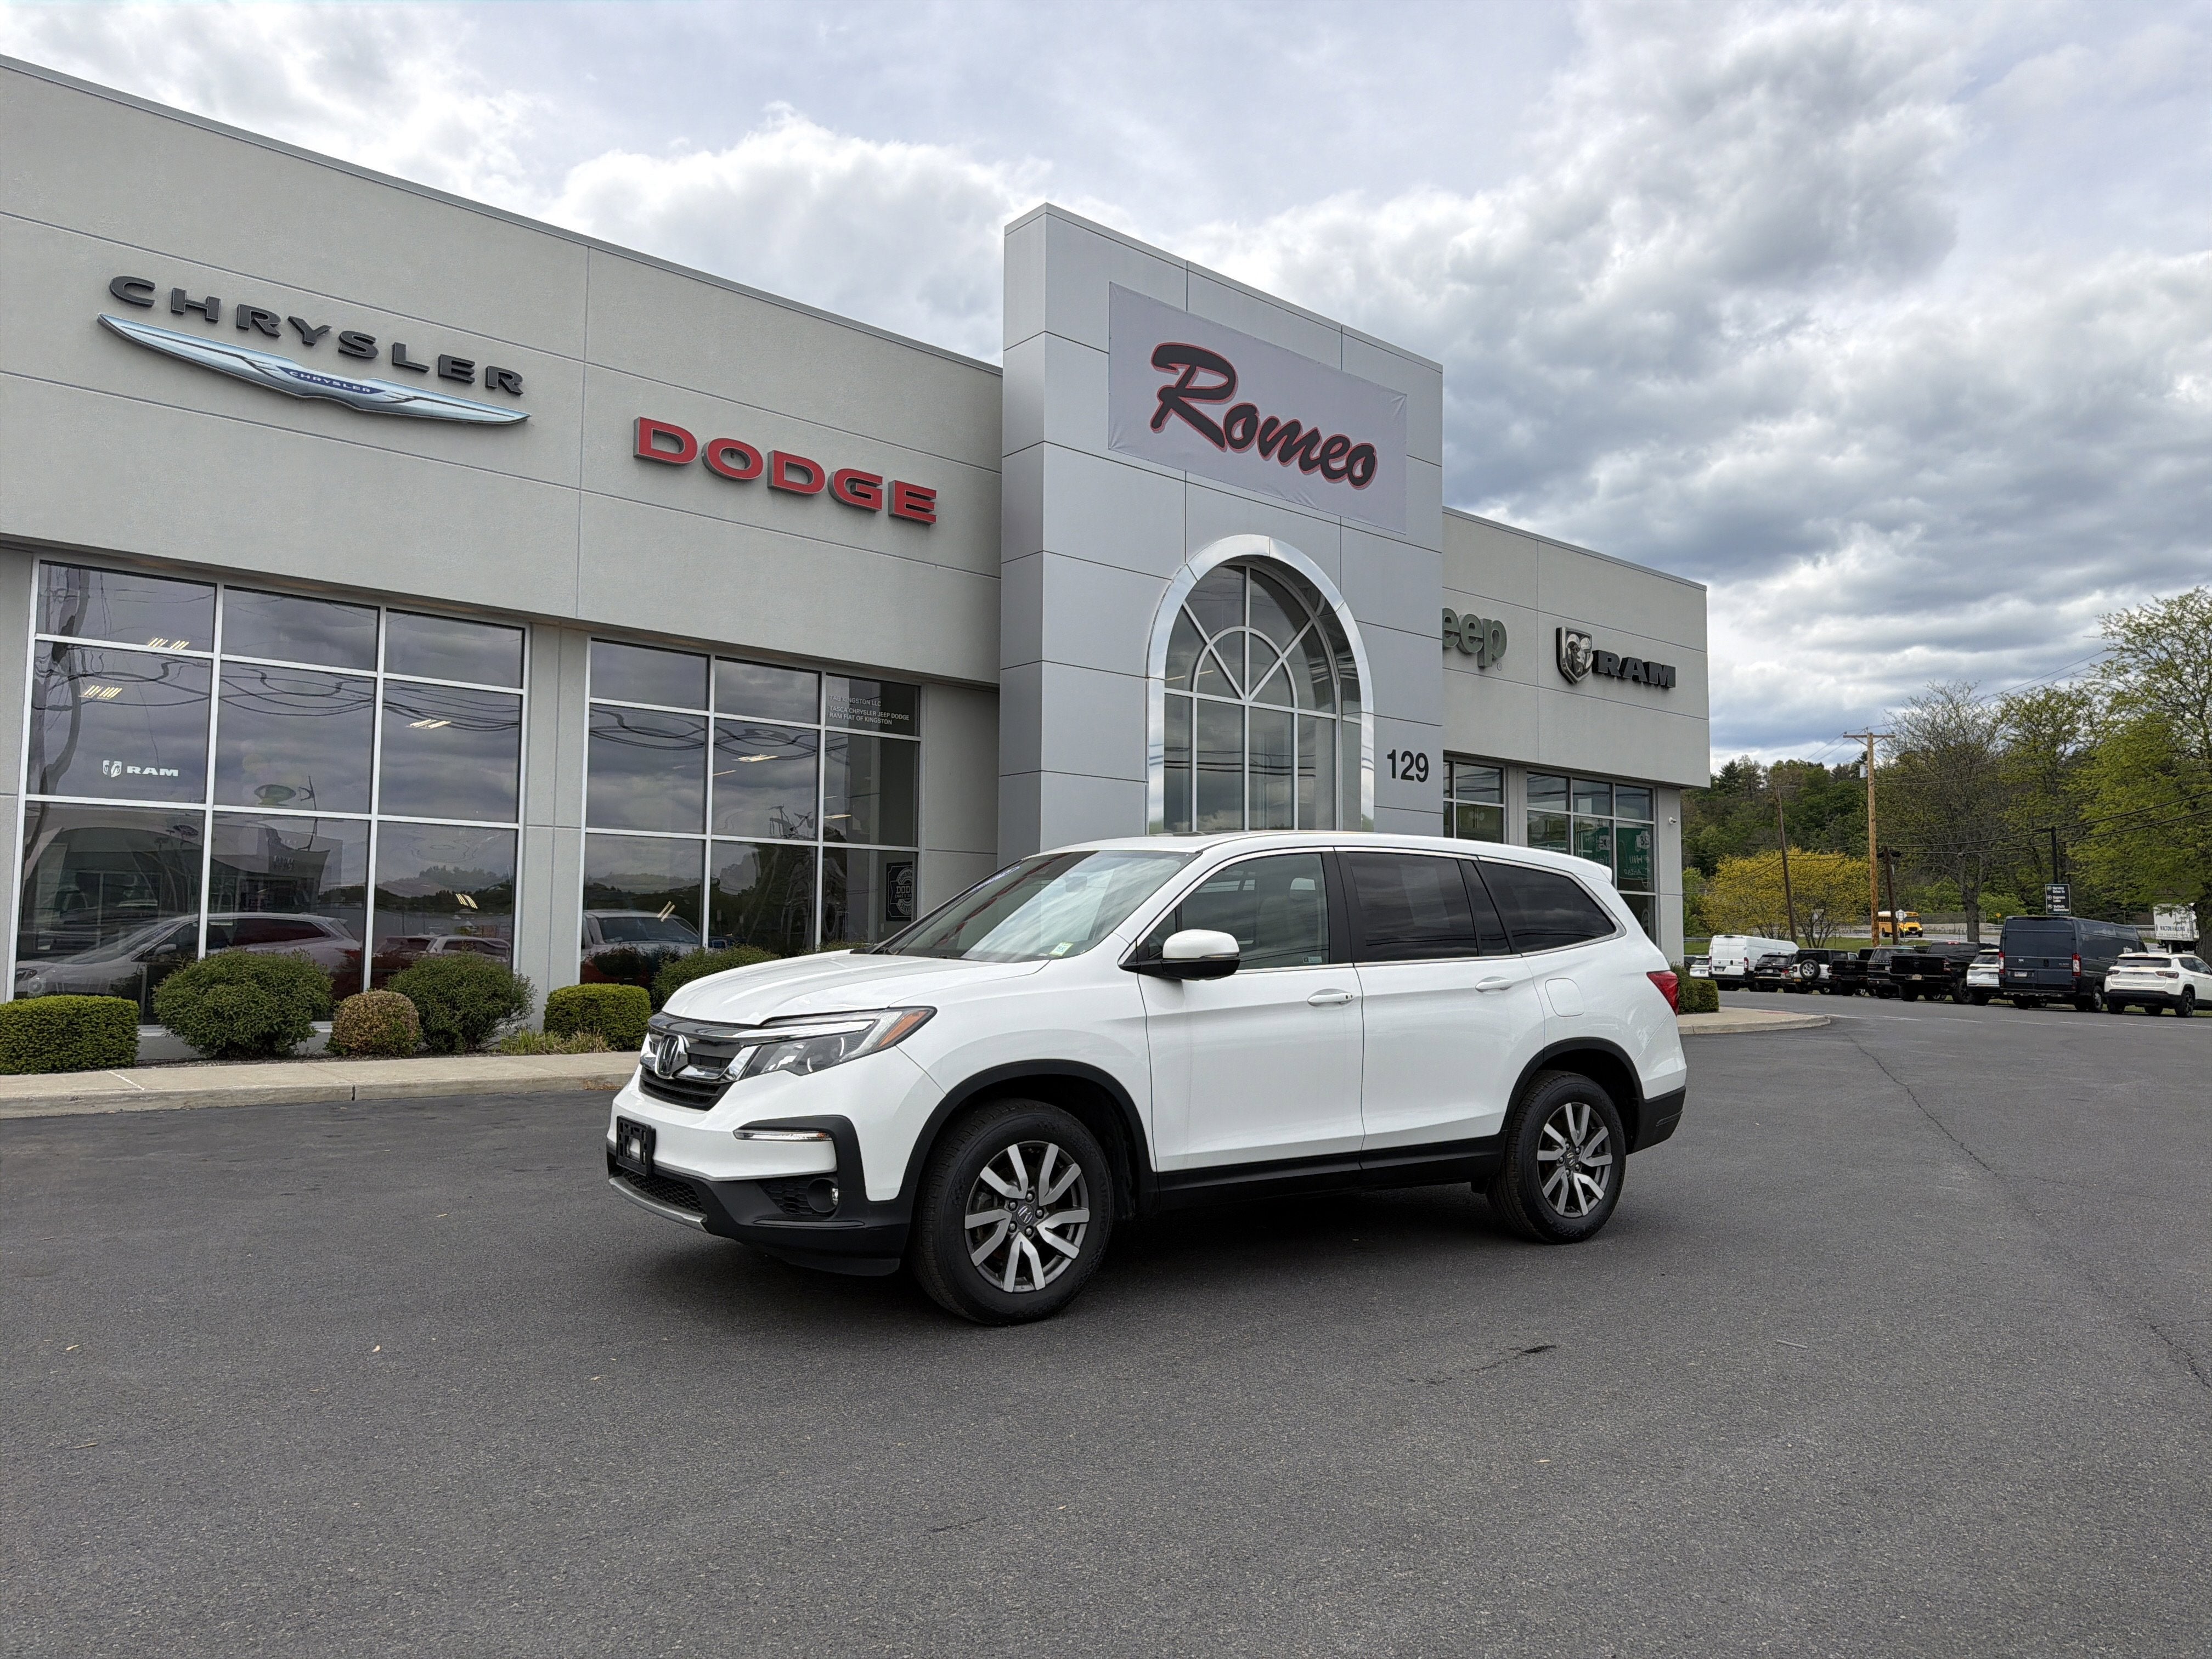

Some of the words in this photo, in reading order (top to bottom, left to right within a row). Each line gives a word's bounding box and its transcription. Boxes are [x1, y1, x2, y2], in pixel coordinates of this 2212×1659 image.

[110, 275, 524, 396] CHRYSLER
[289, 371, 371, 393] CHRYSLER
[1150, 342, 1377, 490] Romeo
[634, 416, 937, 524] DODGE
[1442, 608, 1507, 667] eep
[1592, 650, 1676, 687] RAM
[864, 716, 893, 725] KINGSTON
[127, 766, 179, 776] RAM
[1387, 749, 1429, 783] 129
[896, 885, 912, 894] DOD
